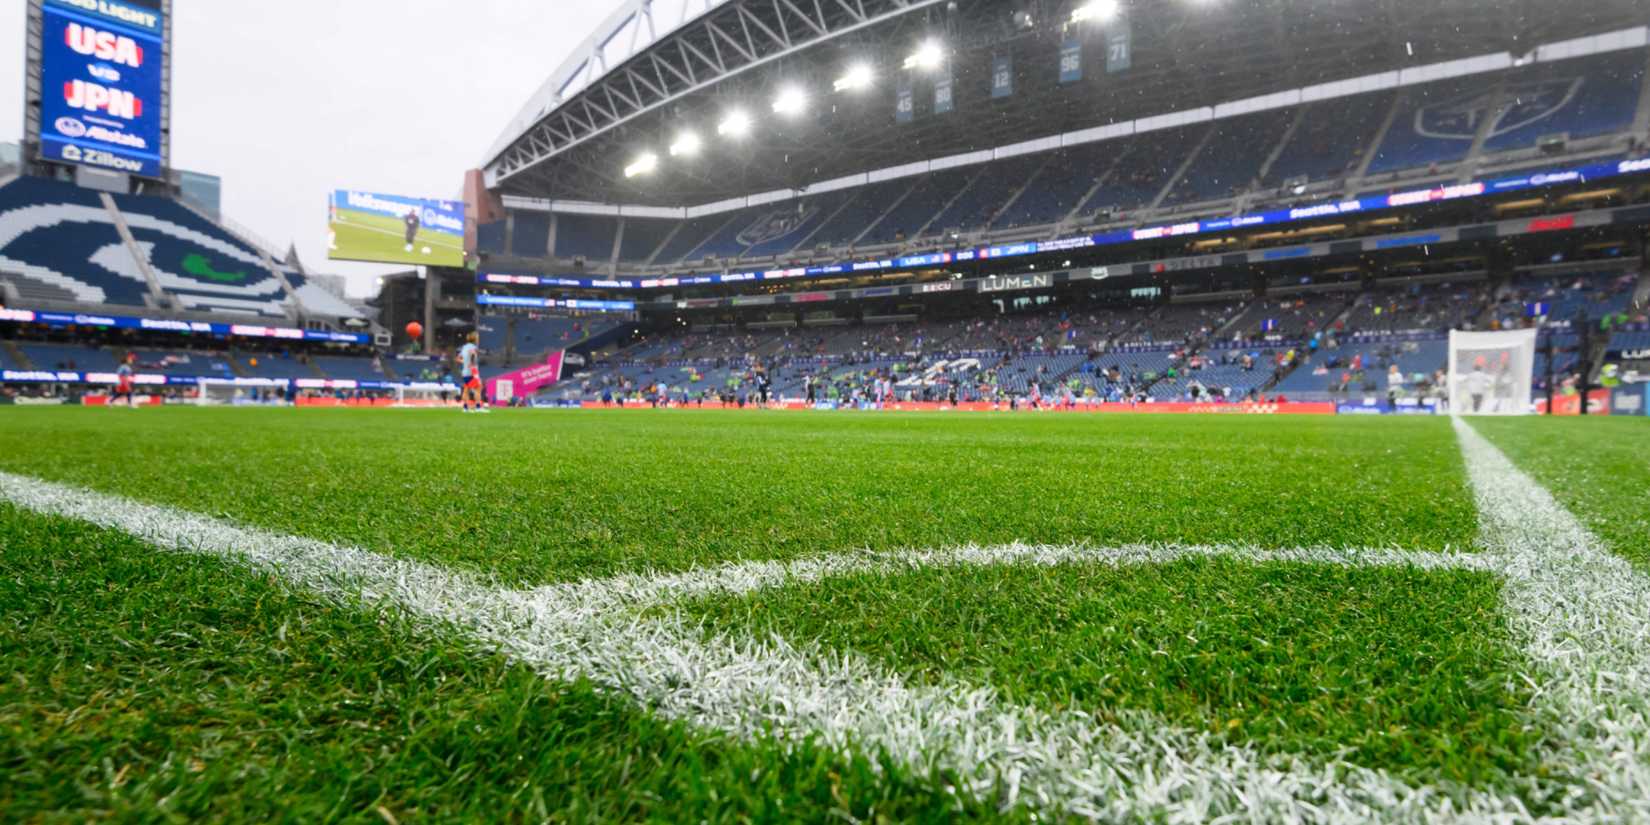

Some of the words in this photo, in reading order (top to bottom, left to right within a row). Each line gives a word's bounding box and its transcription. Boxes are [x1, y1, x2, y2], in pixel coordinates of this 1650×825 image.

[99, 0, 157, 28] LIGHT
[68, 21, 140, 68] USA
[66, 78, 134, 120] JPN
[83, 148, 144, 172] Zillow
[981, 274, 1048, 292] LUMEN
